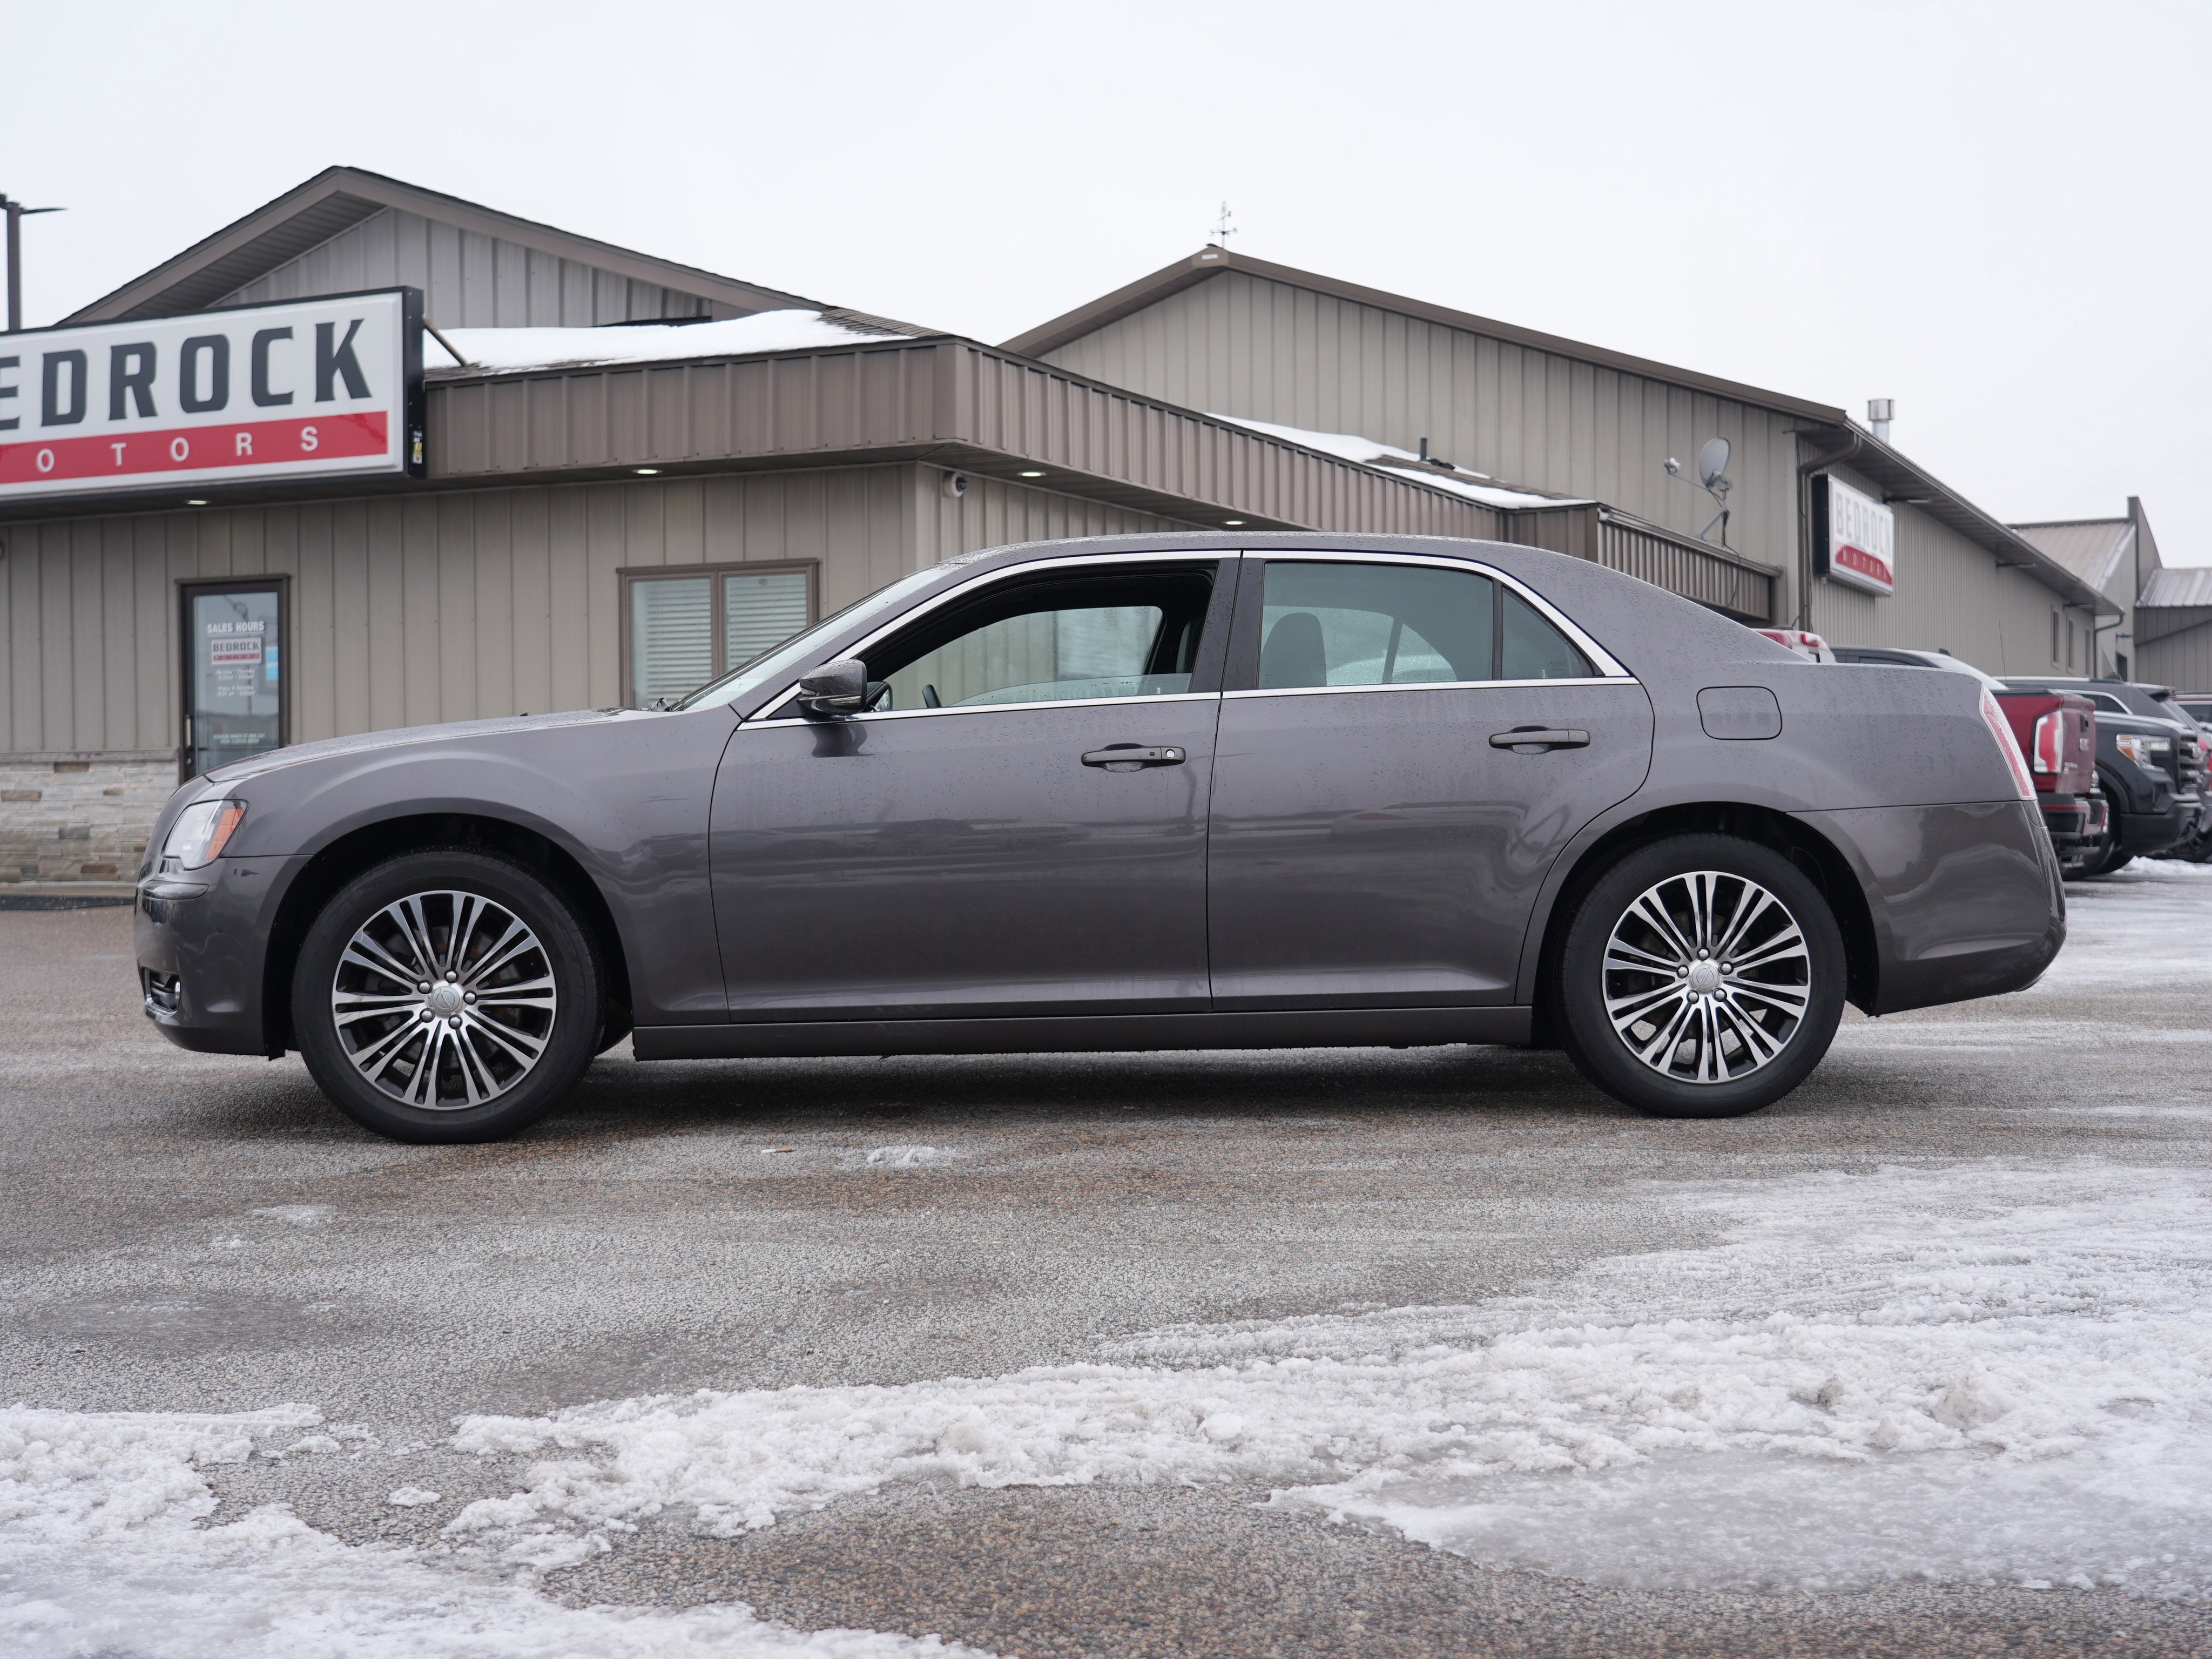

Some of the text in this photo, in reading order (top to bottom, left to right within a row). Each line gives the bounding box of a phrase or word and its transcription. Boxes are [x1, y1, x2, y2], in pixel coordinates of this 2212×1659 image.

[1836, 492, 1891, 558] BEDROCK
[1843, 548, 1887, 579] MOTORS
[207, 621, 265, 634] SALES HOURS
[213, 641, 259, 651] BEDROCK
